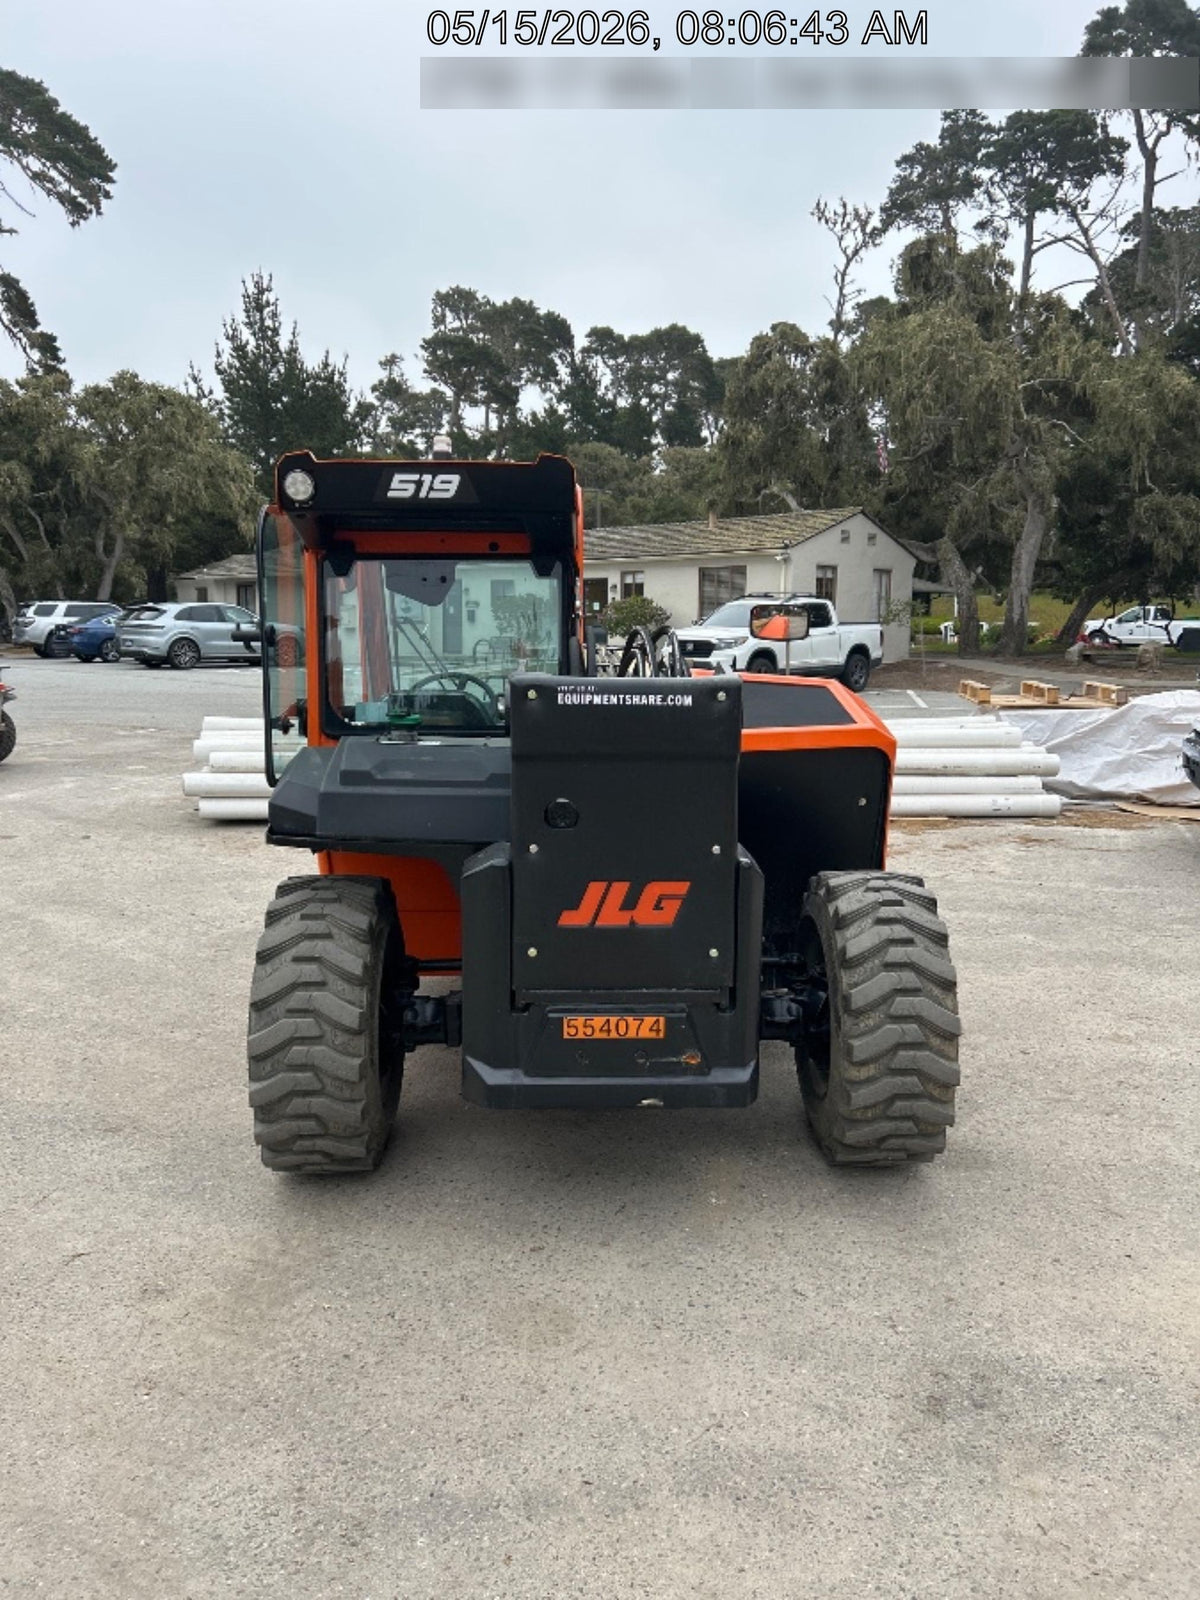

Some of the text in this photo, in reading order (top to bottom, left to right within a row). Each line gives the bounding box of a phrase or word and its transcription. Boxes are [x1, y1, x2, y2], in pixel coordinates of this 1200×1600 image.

[387, 473, 461, 499] 519
[557, 692, 692, 706] EQUIPMENTSHARE.COM
[557, 880, 692, 928] JLG
[566, 1017, 662, 1037] 554074
